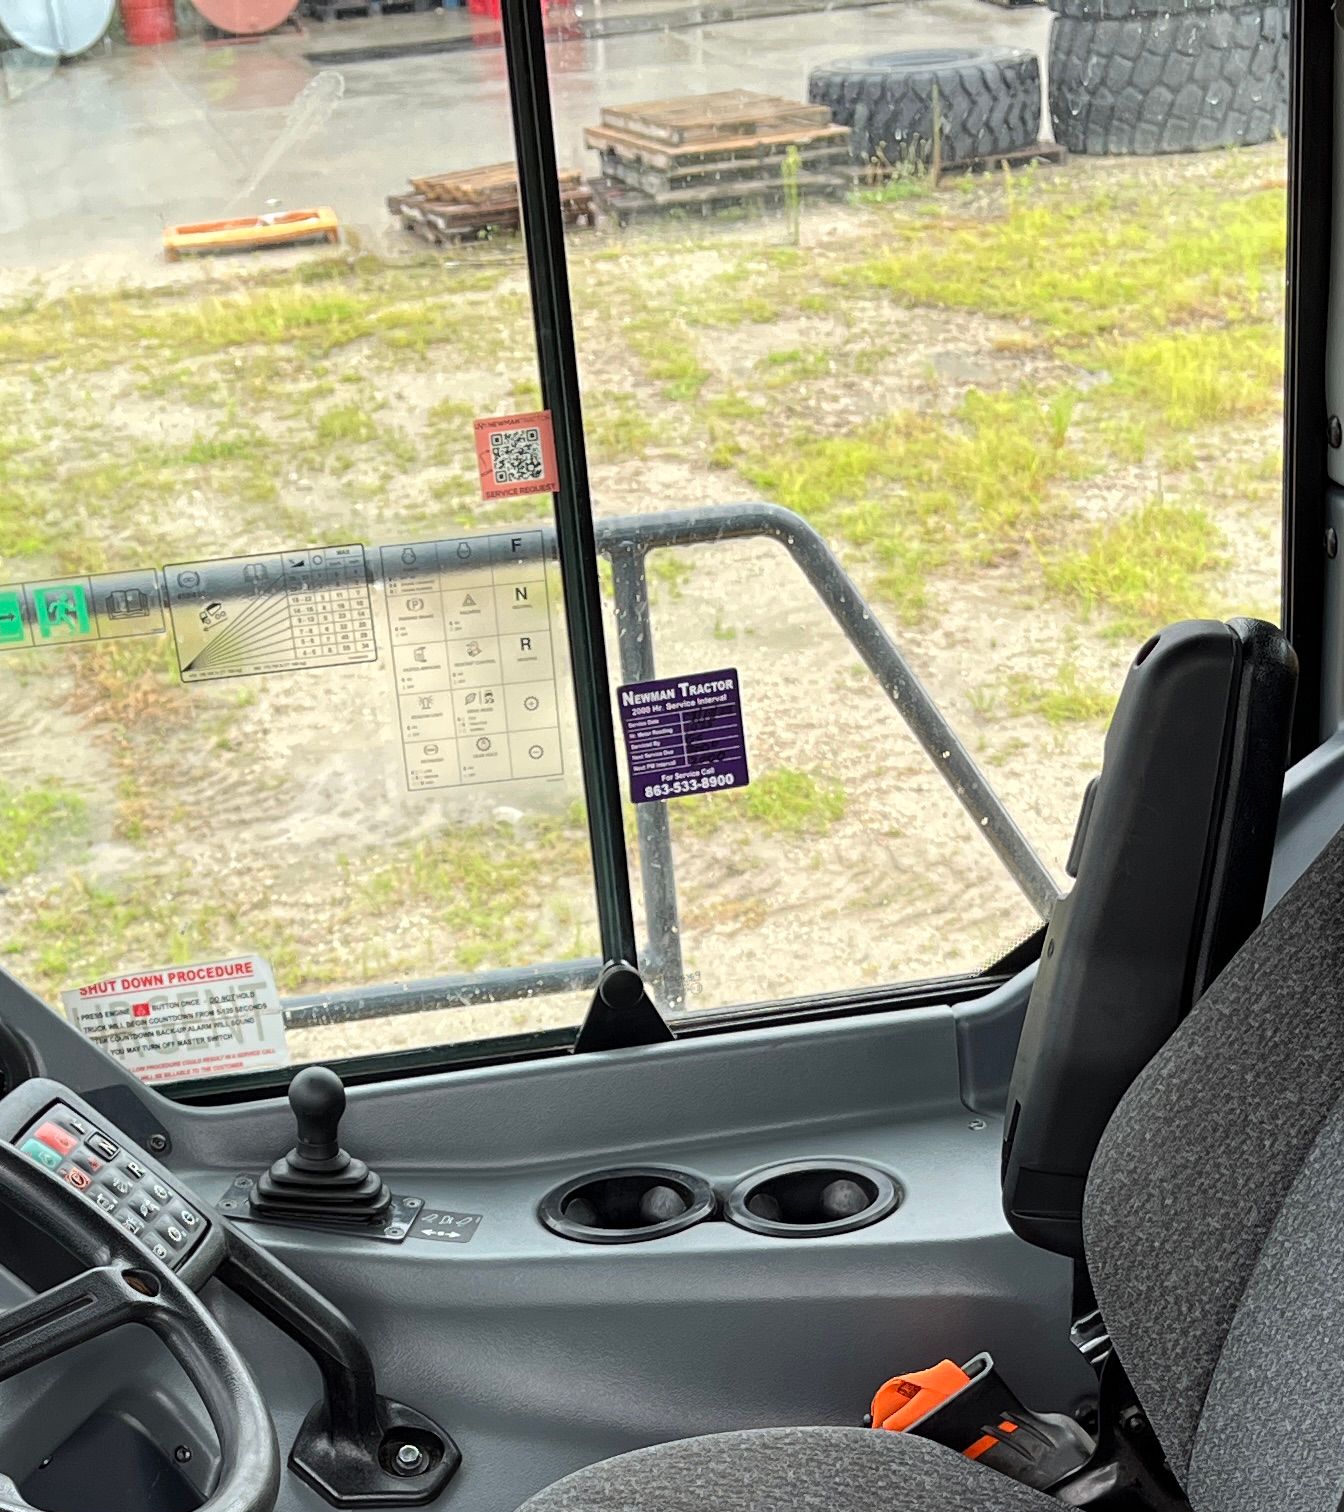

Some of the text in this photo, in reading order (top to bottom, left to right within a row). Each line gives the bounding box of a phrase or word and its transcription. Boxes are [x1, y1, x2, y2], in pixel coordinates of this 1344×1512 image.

[486, 483, 556, 499] SERVICE REQUEST
[511, 538, 522, 552] F
[515, 587, 528, 601] N
[520, 637, 532, 651] R
[622, 679, 734, 706] NEWMAN TRACTOR
[665, 700, 696, 711] Service
[697, 693, 728, 705] Interval
[652, 728, 674, 737] Reading
[660, 766, 716, 782] For Service Call
[644, 773, 735, 798] 863-533-8900
[79, 962, 254, 996] SHUT DOWN PROCEDURE
[81, 1012, 103, 1020] PRESS
[105, 1008, 130, 1017] ENGINE
[152, 1002, 179, 1011] BUTTON
[180, 999, 199, 1007] ONCE
[221, 994, 235, 1002] NOT
[236, 992, 255, 1000] HOLD
[84, 1025, 106, 1033] TRUCK
[149, 1013, 194, 1024] COUNTDOWN
[196, 1010, 214, 1018] FROM
[235, 1003, 268, 1013] SECONDS
[110, 1031, 154, 1042] COUNTDOWN
[187, 1023, 212, 1033] ALARM
[231, 1017, 255, 1026] SOUND
[142, 1043, 161, 1051] TURN
[177, 1037, 205, 1046] MASTER
[207, 1034, 233, 1043] SWITCH
[99, 1141, 117, 1156] N
[127, 1161, 146, 1179] R
